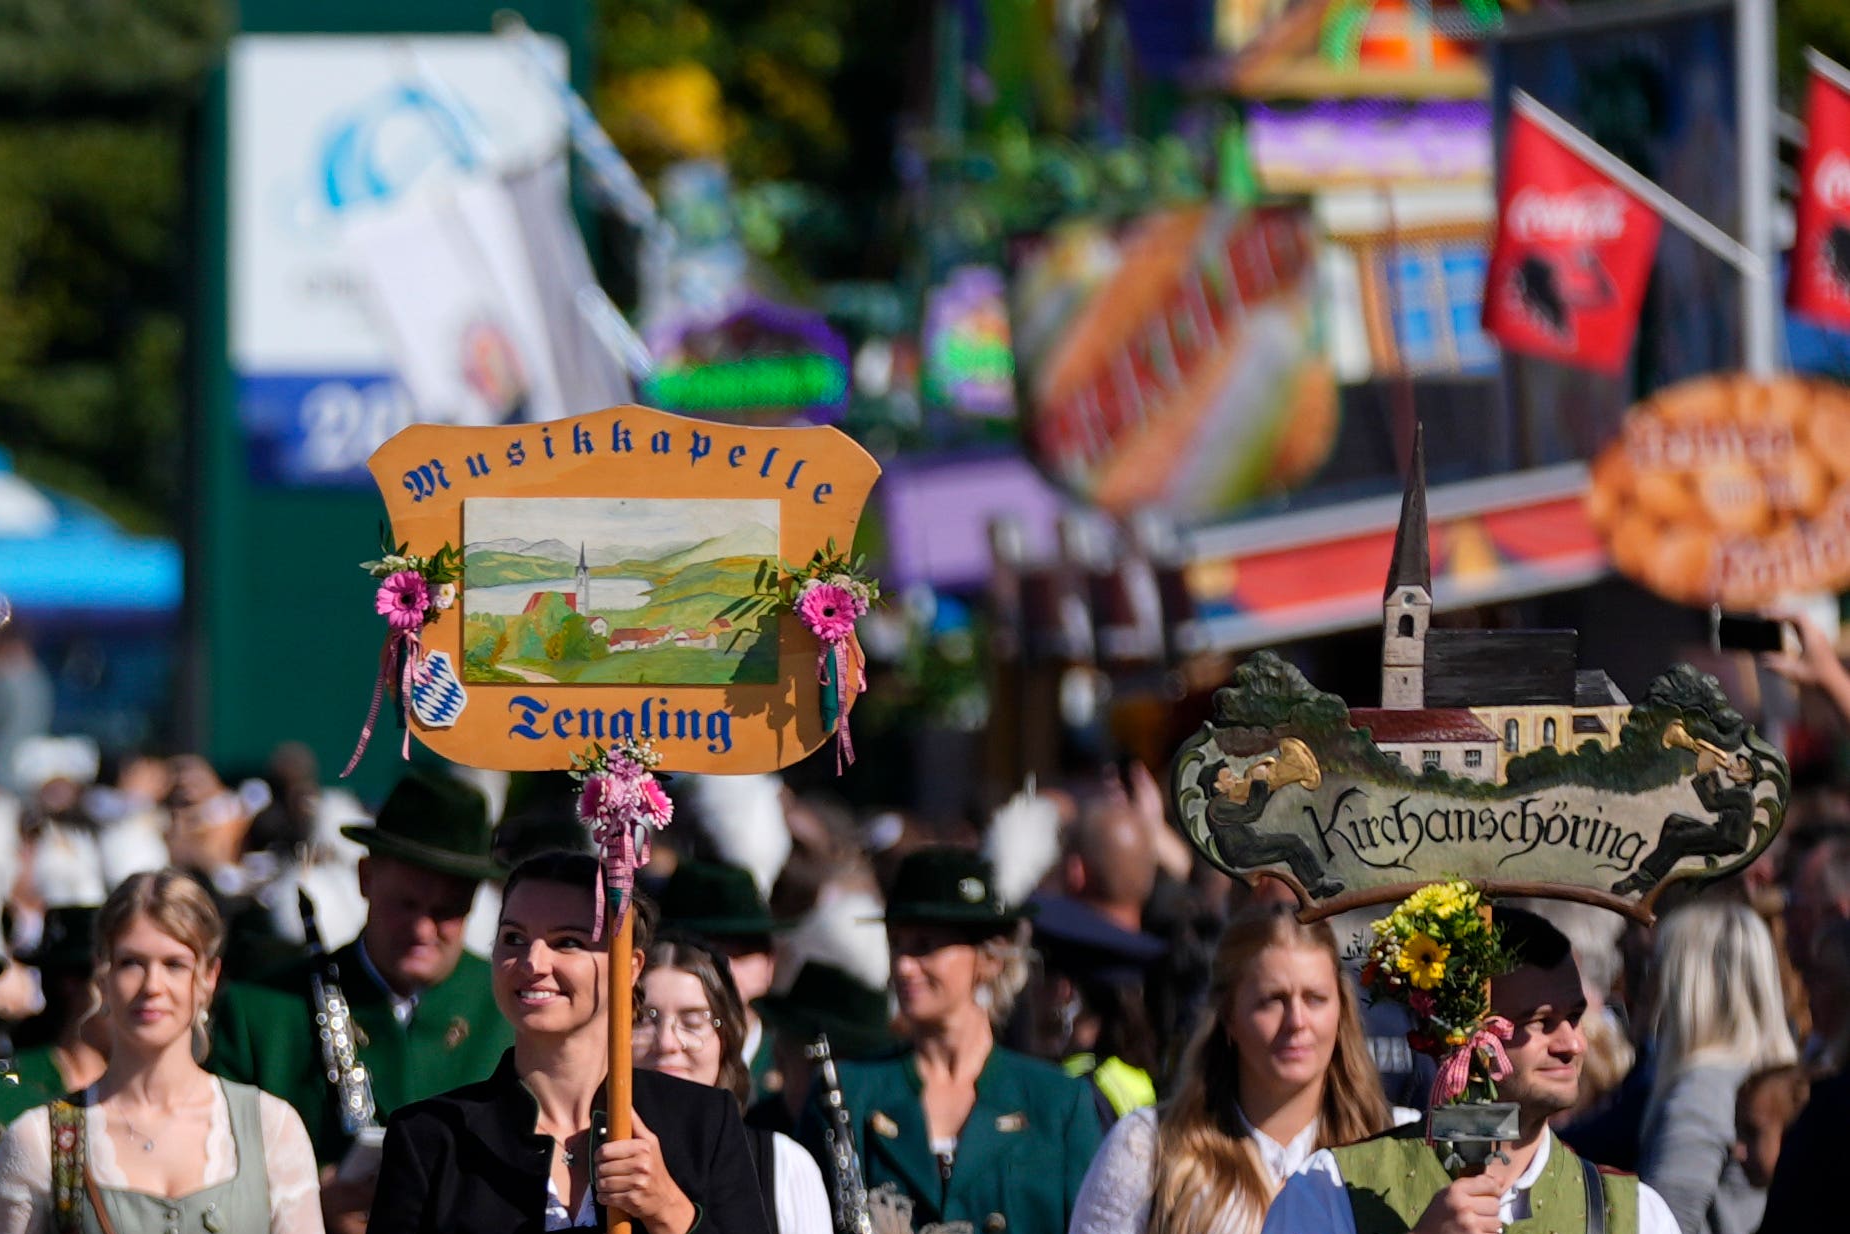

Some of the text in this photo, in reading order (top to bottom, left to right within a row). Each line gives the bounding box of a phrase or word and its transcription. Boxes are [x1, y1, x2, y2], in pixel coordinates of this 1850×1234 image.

[402, 420, 834, 505] Musikkapelle
[508, 694, 733, 755] Tengling
[1302, 785, 1650, 872] Kirchanschöring
